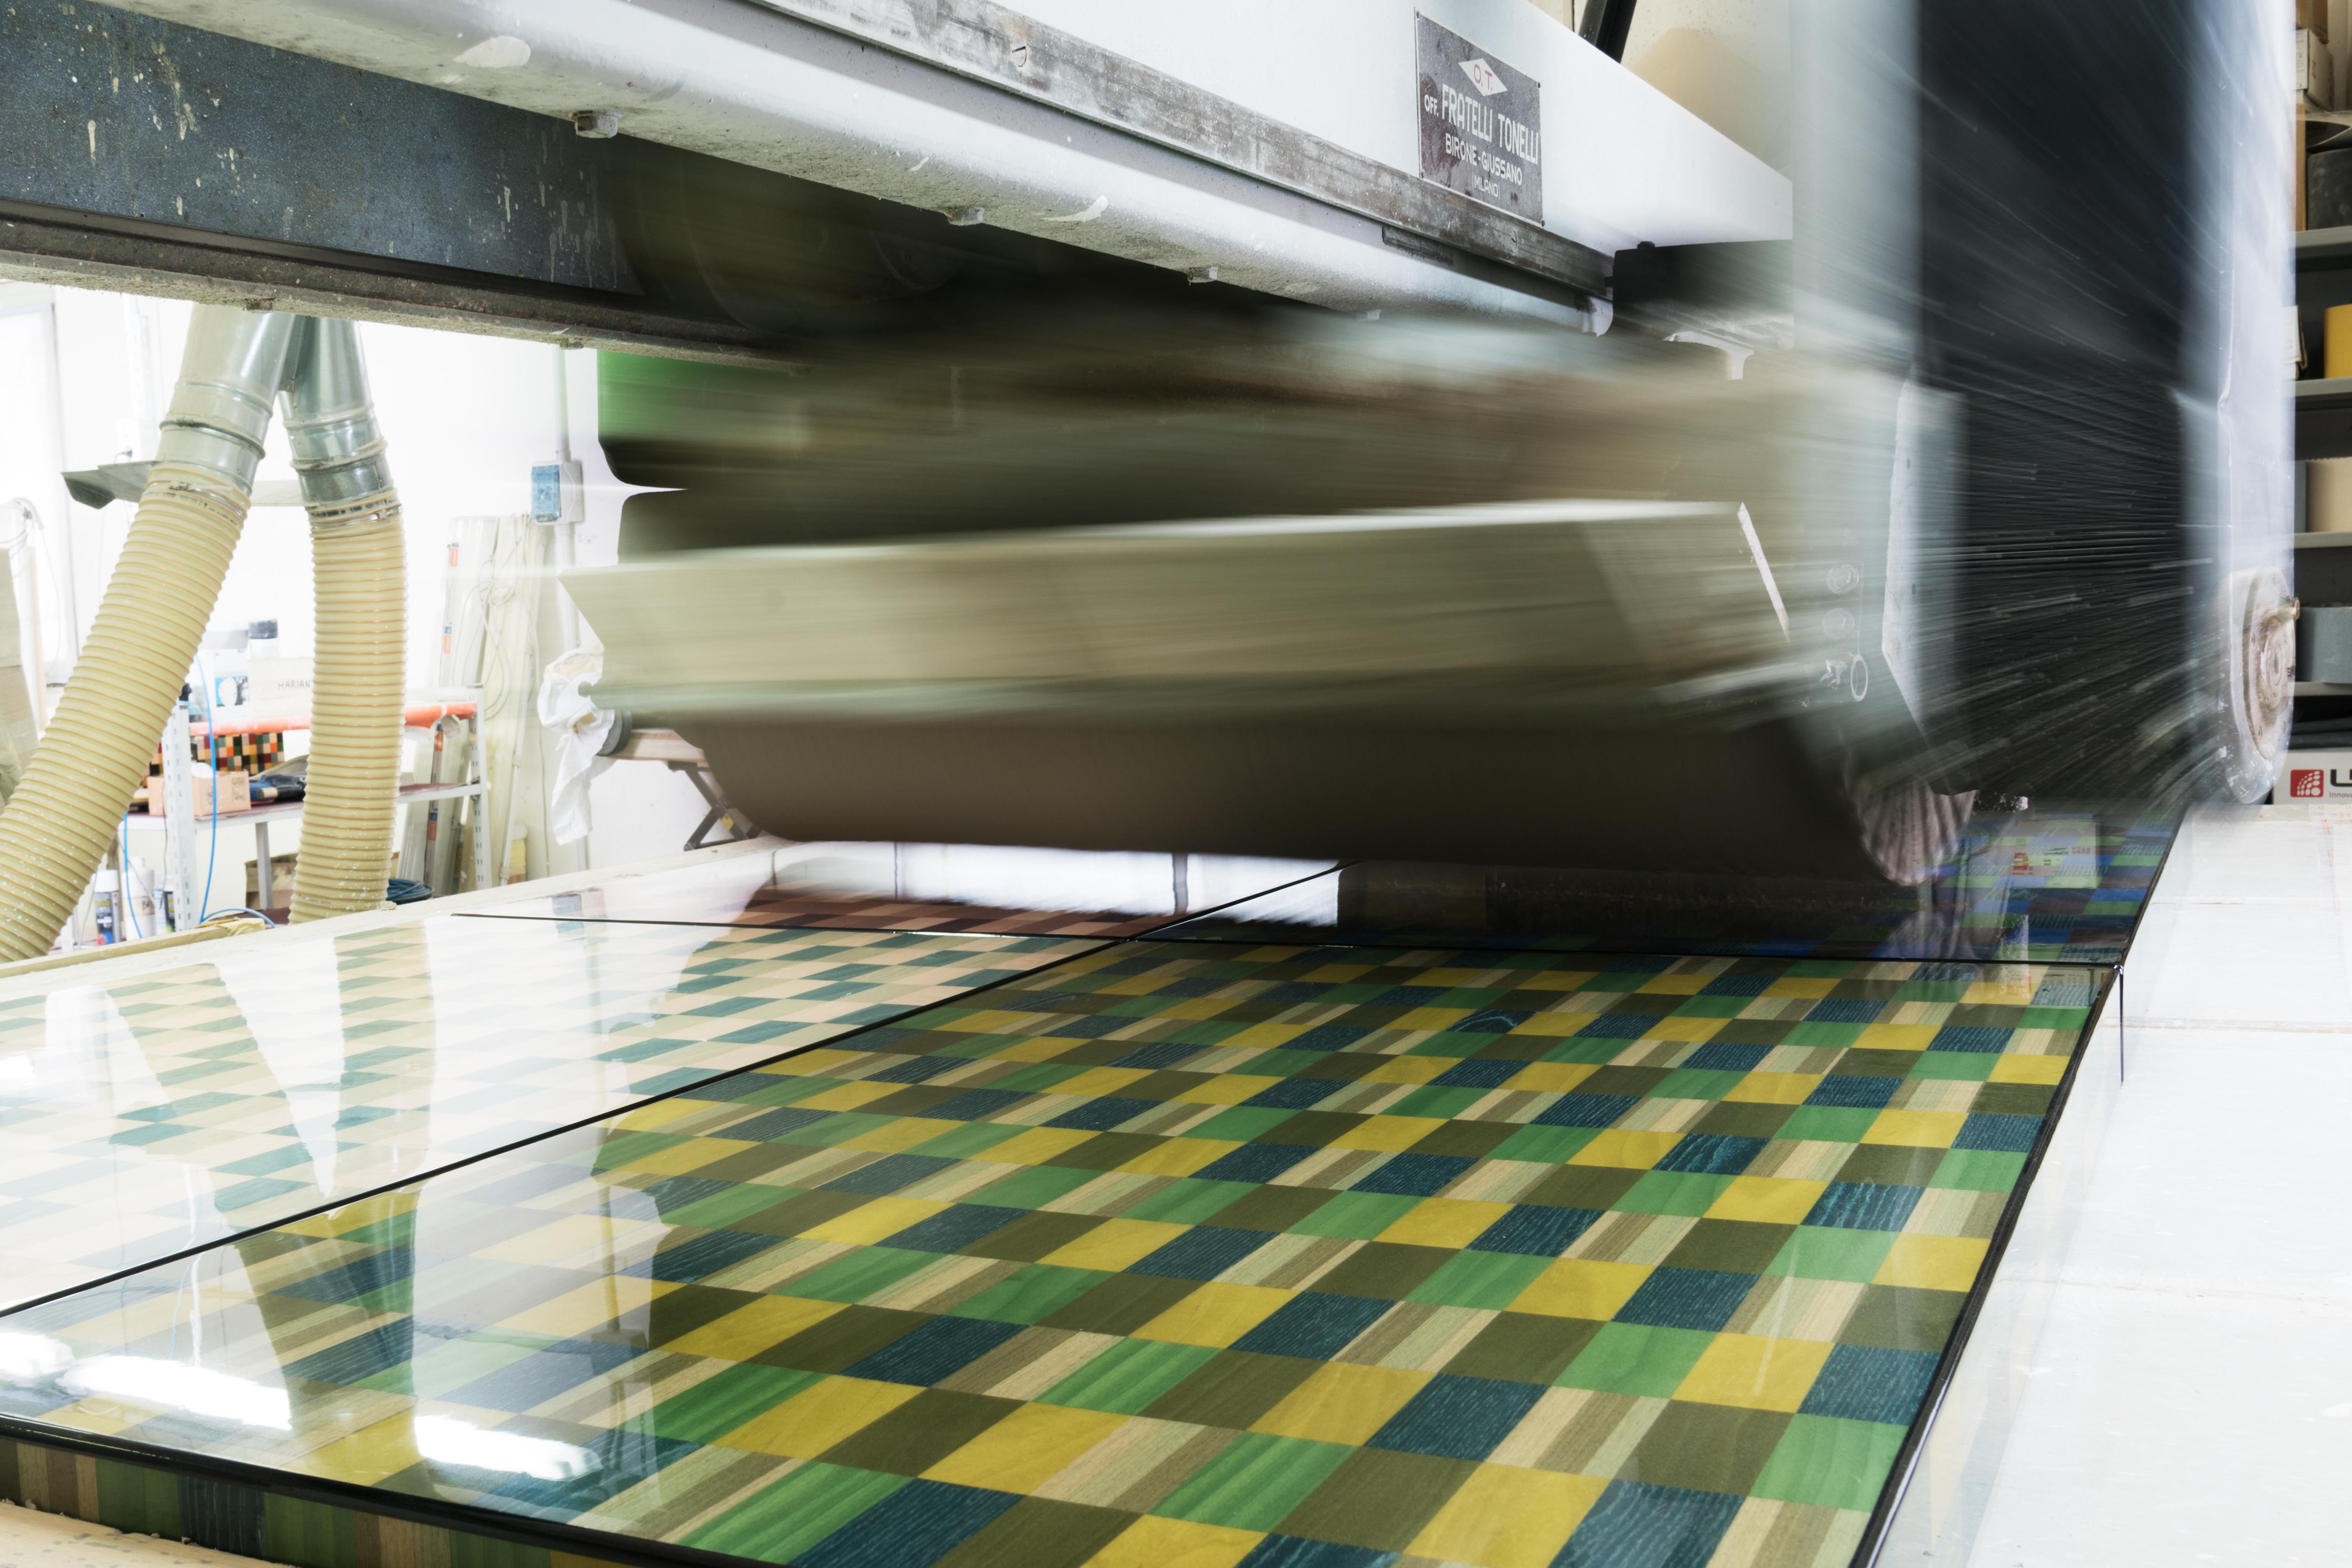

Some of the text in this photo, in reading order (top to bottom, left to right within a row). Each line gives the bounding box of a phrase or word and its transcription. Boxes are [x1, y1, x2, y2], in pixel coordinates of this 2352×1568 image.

[1424, 83, 1539, 165] OFF. FRATELLI TONELLI
[1472, 172, 1501, 200] (MILANO)
